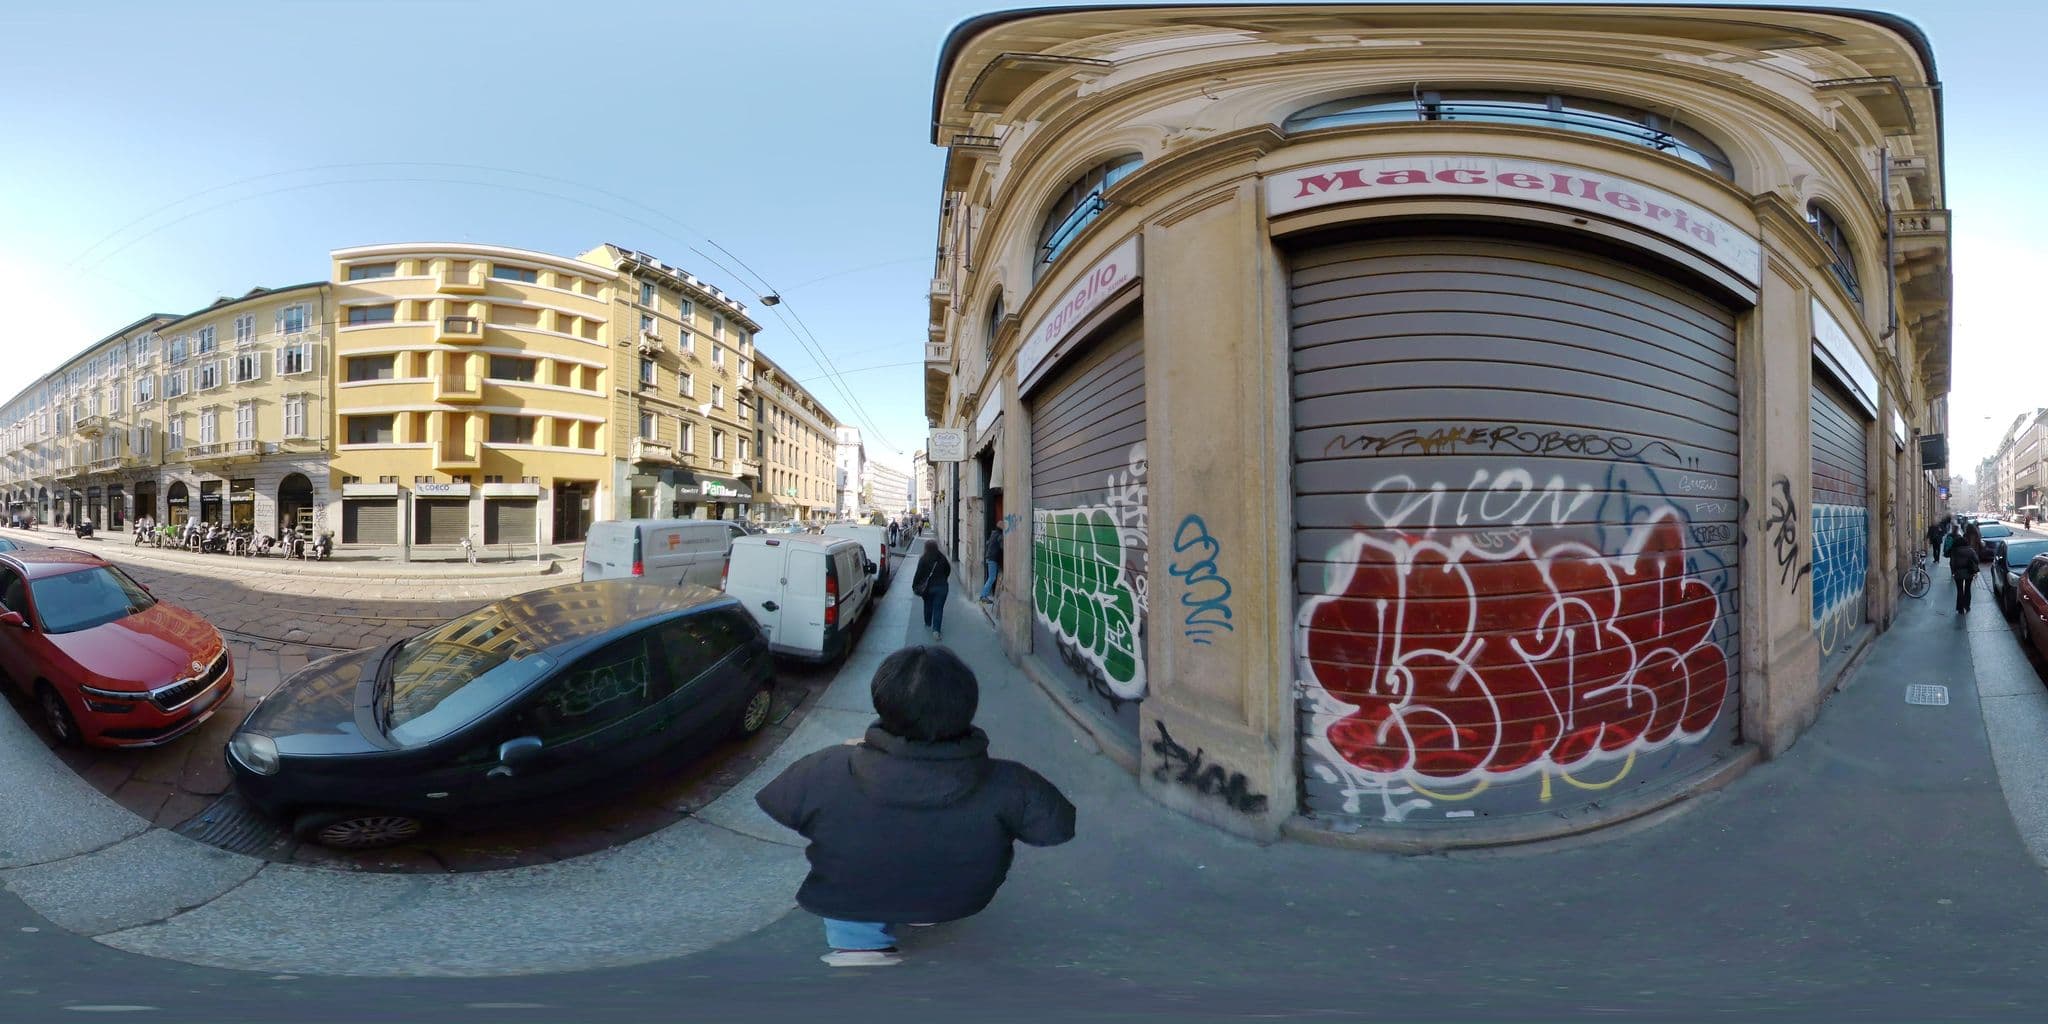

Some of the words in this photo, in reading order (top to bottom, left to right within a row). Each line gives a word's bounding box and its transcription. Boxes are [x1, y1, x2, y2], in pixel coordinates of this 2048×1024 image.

[1294, 168, 1717, 248] Macelleria
[1045, 263, 1117, 342] agnello
[701, 480, 726, 497] Pam
